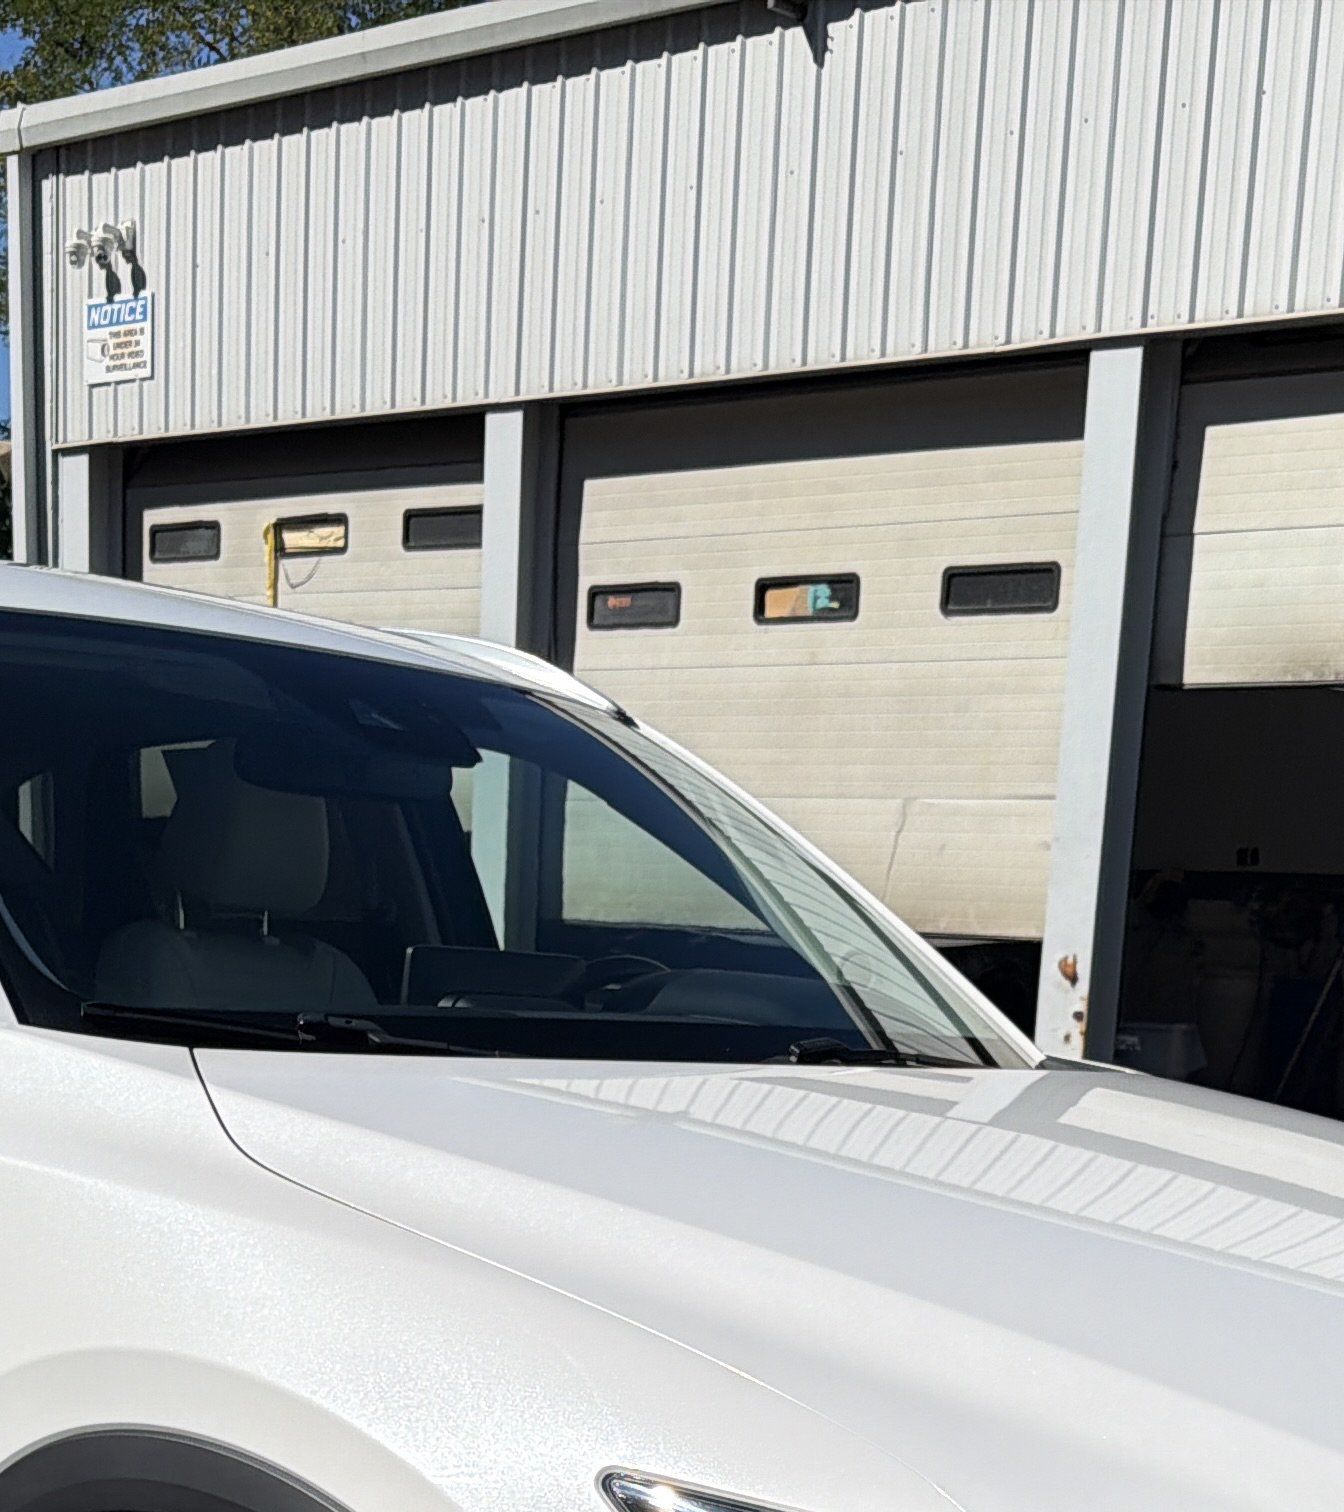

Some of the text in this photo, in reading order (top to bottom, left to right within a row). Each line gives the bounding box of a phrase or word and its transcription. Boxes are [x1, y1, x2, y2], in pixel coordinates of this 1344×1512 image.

[89, 300, 145, 326] NOTICE
[123, 328, 137, 337] AREA
[113, 340, 133, 350] UNDER
[105, 360, 147, 373] SURVEILLANCE
